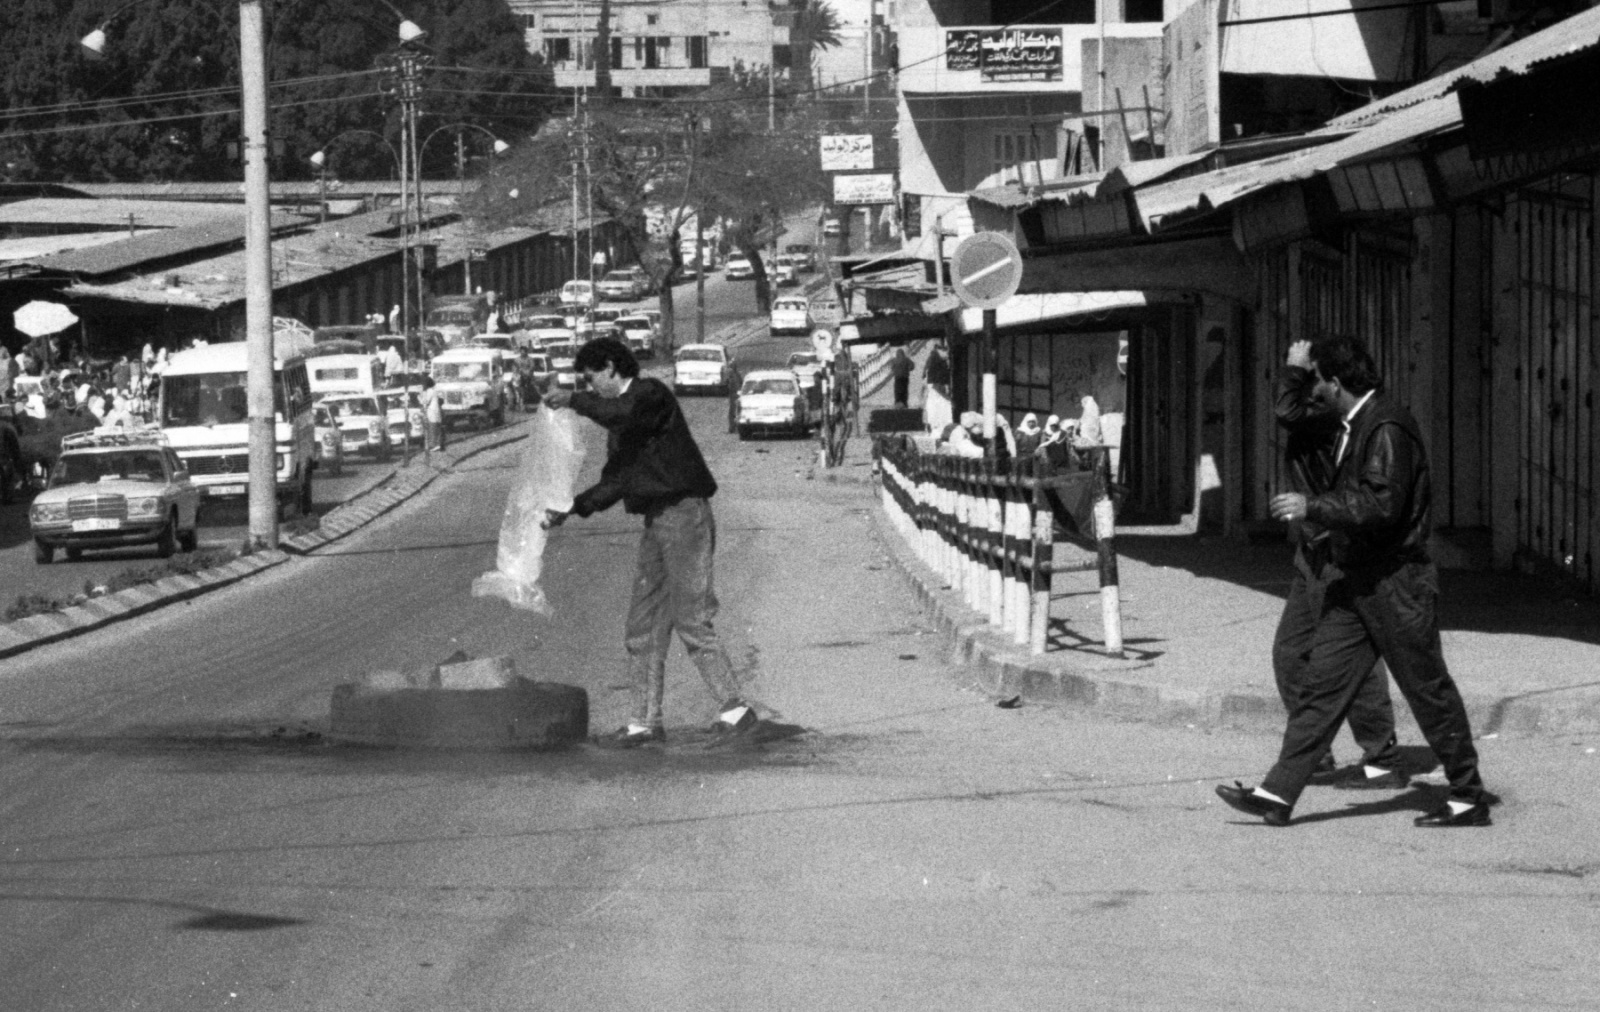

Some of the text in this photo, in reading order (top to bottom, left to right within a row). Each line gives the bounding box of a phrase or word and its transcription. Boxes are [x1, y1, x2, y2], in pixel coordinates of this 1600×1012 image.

[981, 30, 1021, 52] الوليد
[1019, 31, 1062, 50] مركز
[849, 137, 872, 153] مركز
